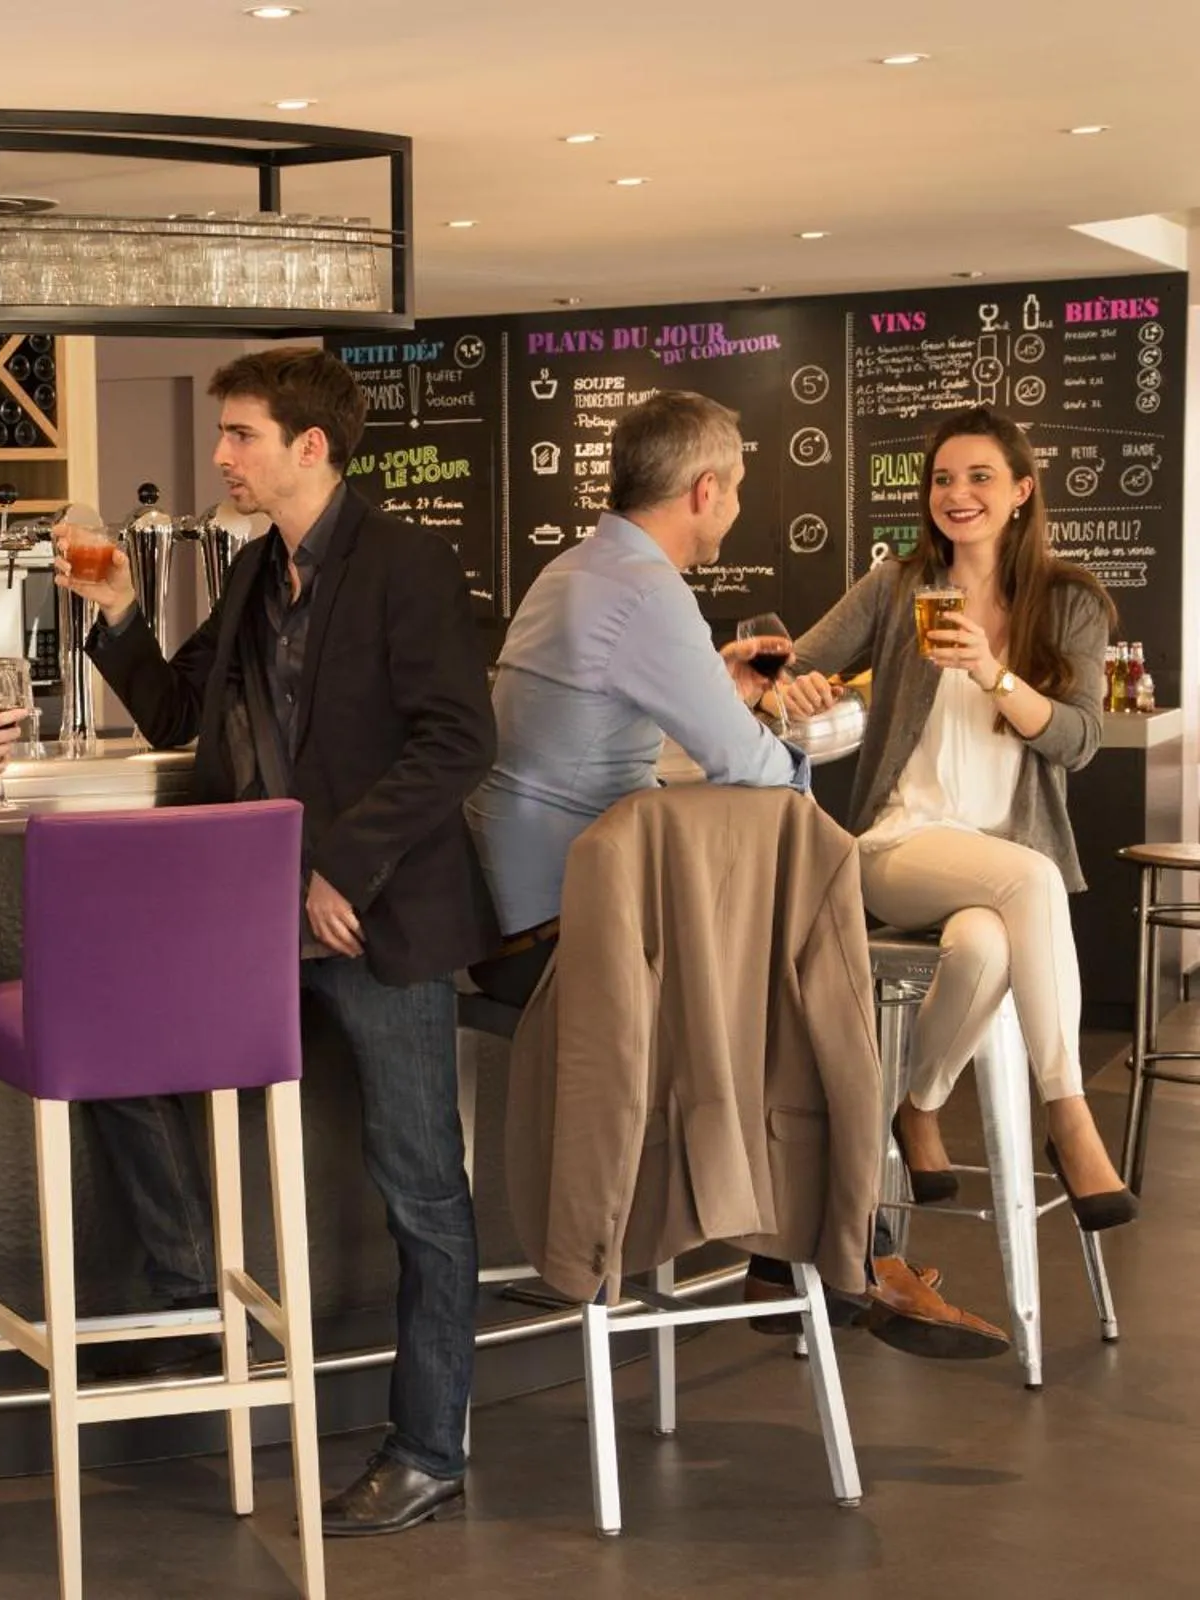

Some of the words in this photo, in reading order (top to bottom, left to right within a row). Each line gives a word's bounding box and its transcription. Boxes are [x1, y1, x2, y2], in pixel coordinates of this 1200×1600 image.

[1065, 296, 1159, 323] BIÈRES
[871, 312, 926, 333] VINS
[528, 329, 604, 354] PLATS
[612, 326, 648, 349] DU
[655, 322, 726, 346] JOUR
[341, 345, 397, 363] PETIT
[663, 349, 686, 365] DU
[691, 334, 781, 360] COMPTOIR
[383, 368, 402, 379] LES
[426, 370, 462, 381] BUFFET
[574, 376, 625, 390] SOUPE
[574, 392, 625, 408] TENDREMENT
[575, 443, 604, 457] LES
[1071, 446, 1099, 460] PETITE
[346, 455, 375, 477] AU
[379, 445, 438, 472] JOUR
[575, 461, 588, 475] ILS
[590, 460, 610, 475] SONT
[385, 466, 407, 489] LE
[411, 459, 471, 484] JOUR
[416, 497, 430, 510] 27
[1061, 520, 1095, 541] VOUS
